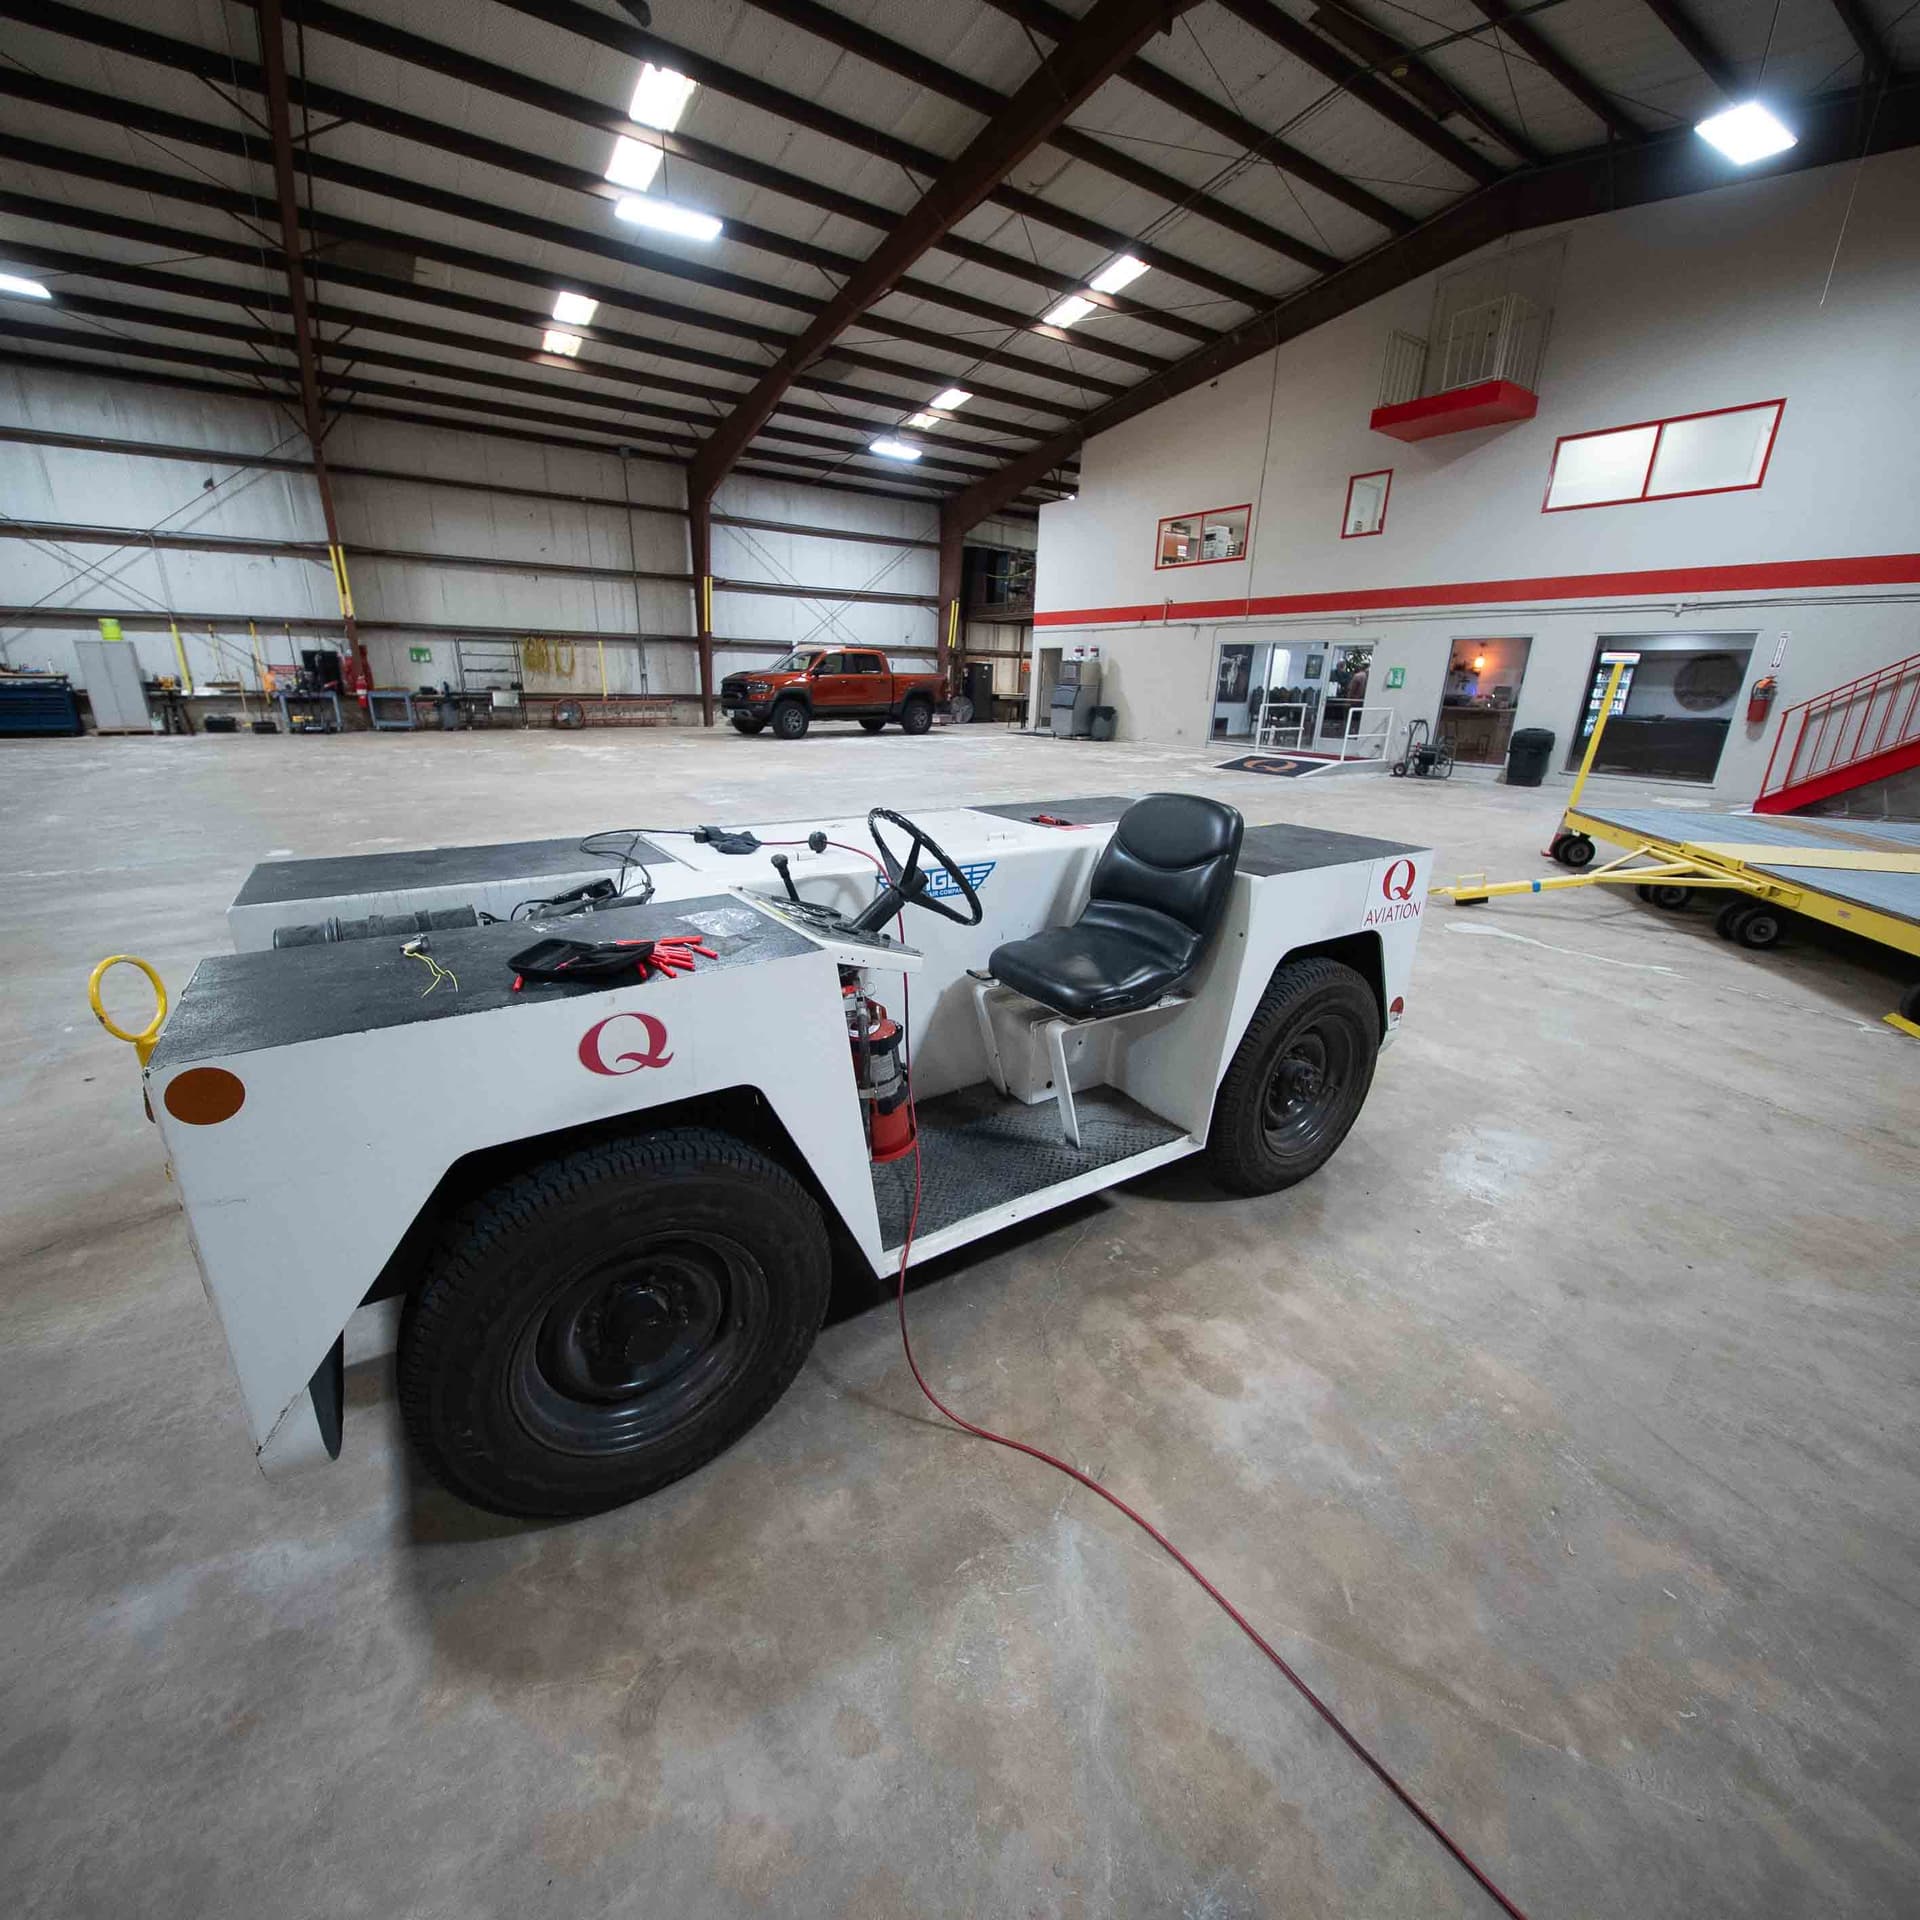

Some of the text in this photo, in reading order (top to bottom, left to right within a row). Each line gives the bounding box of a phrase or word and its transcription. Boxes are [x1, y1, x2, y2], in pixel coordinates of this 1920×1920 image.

[1243, 758, 1298, 772] Q
[1382, 859, 1416, 901] Q
[1363, 902, 1422, 926] AVIATION
[578, 1013, 674, 1076] Q
